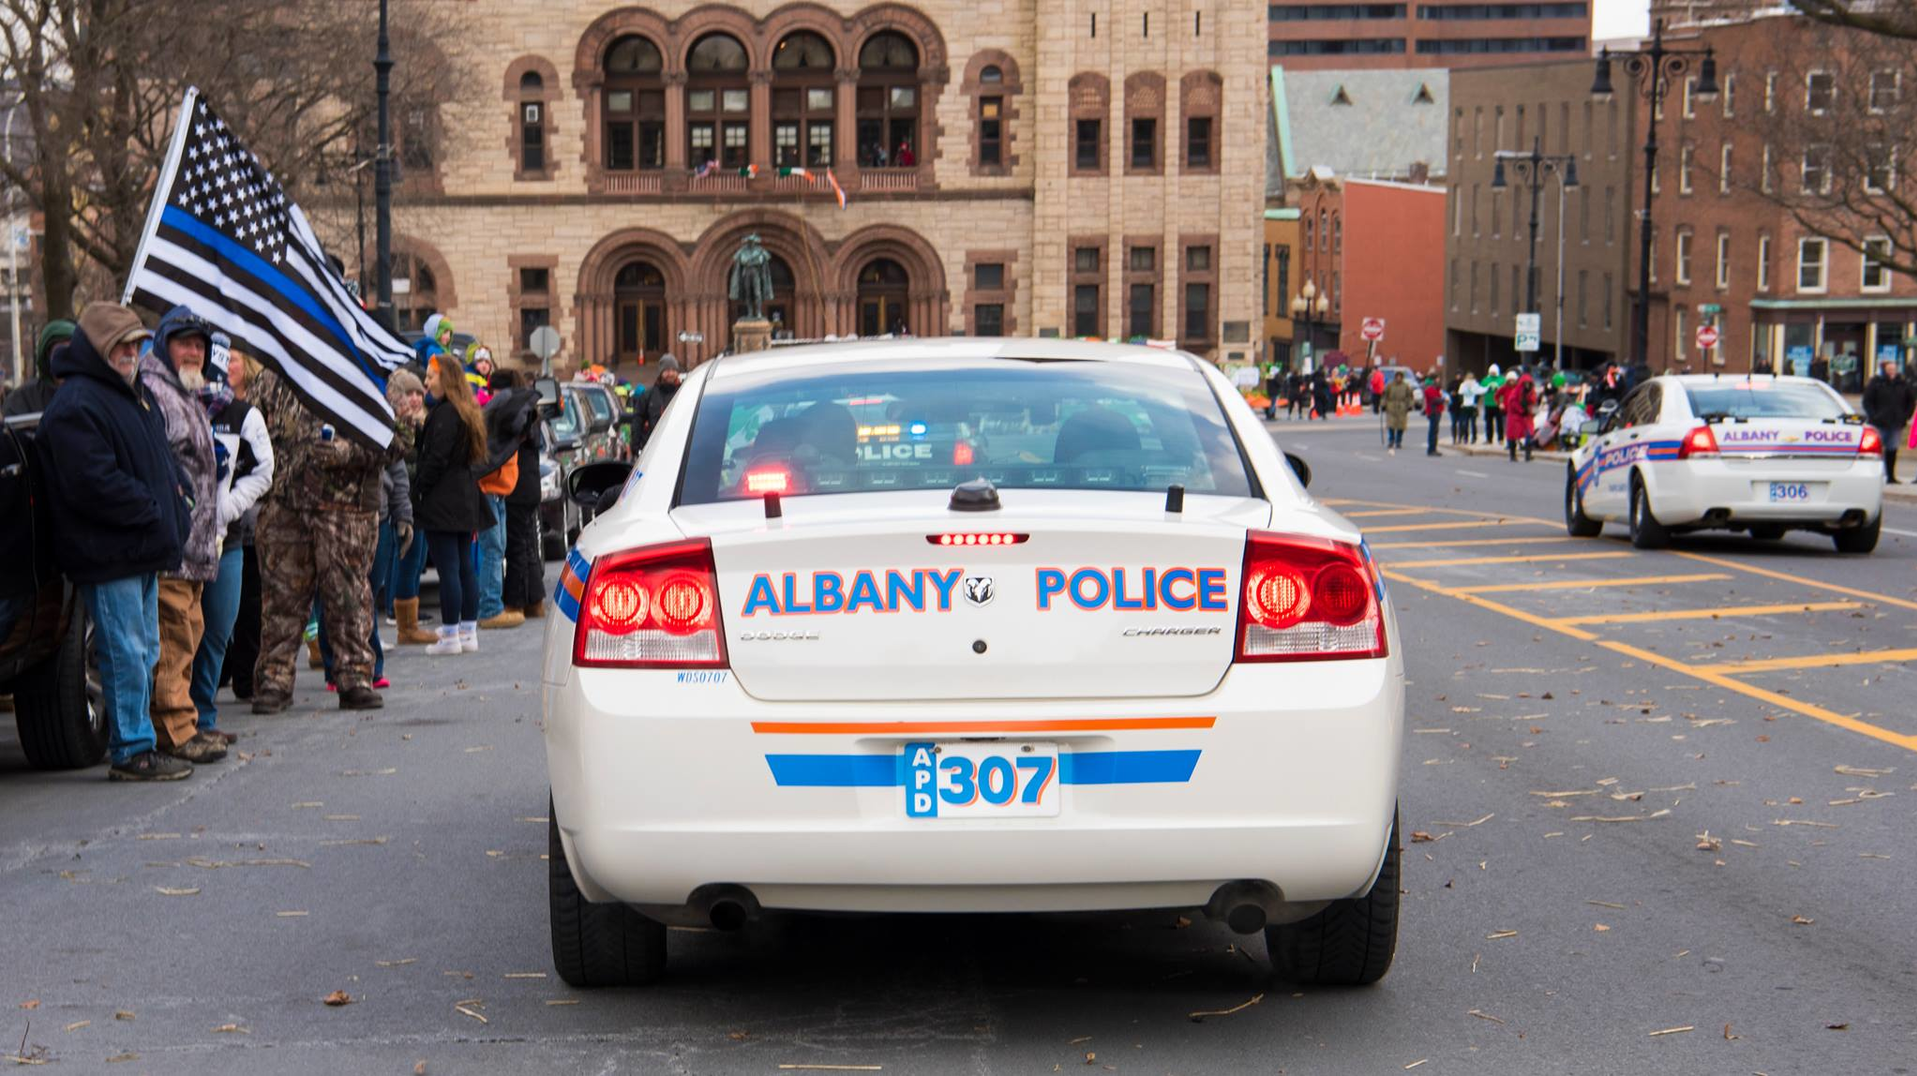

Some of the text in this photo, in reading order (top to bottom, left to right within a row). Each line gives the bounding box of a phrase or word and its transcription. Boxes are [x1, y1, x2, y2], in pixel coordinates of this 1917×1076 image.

[1723, 431, 1852, 442] ALBANY POLICE
[1777, 485, 1808, 499] 306
[741, 566, 1229, 617] ALBANY POLICE
[740, 629, 820, 642] DODGE
[1122, 625, 1222, 637] CHARGER
[912, 748, 932, 813] APD
[938, 755, 1057, 808] 307
